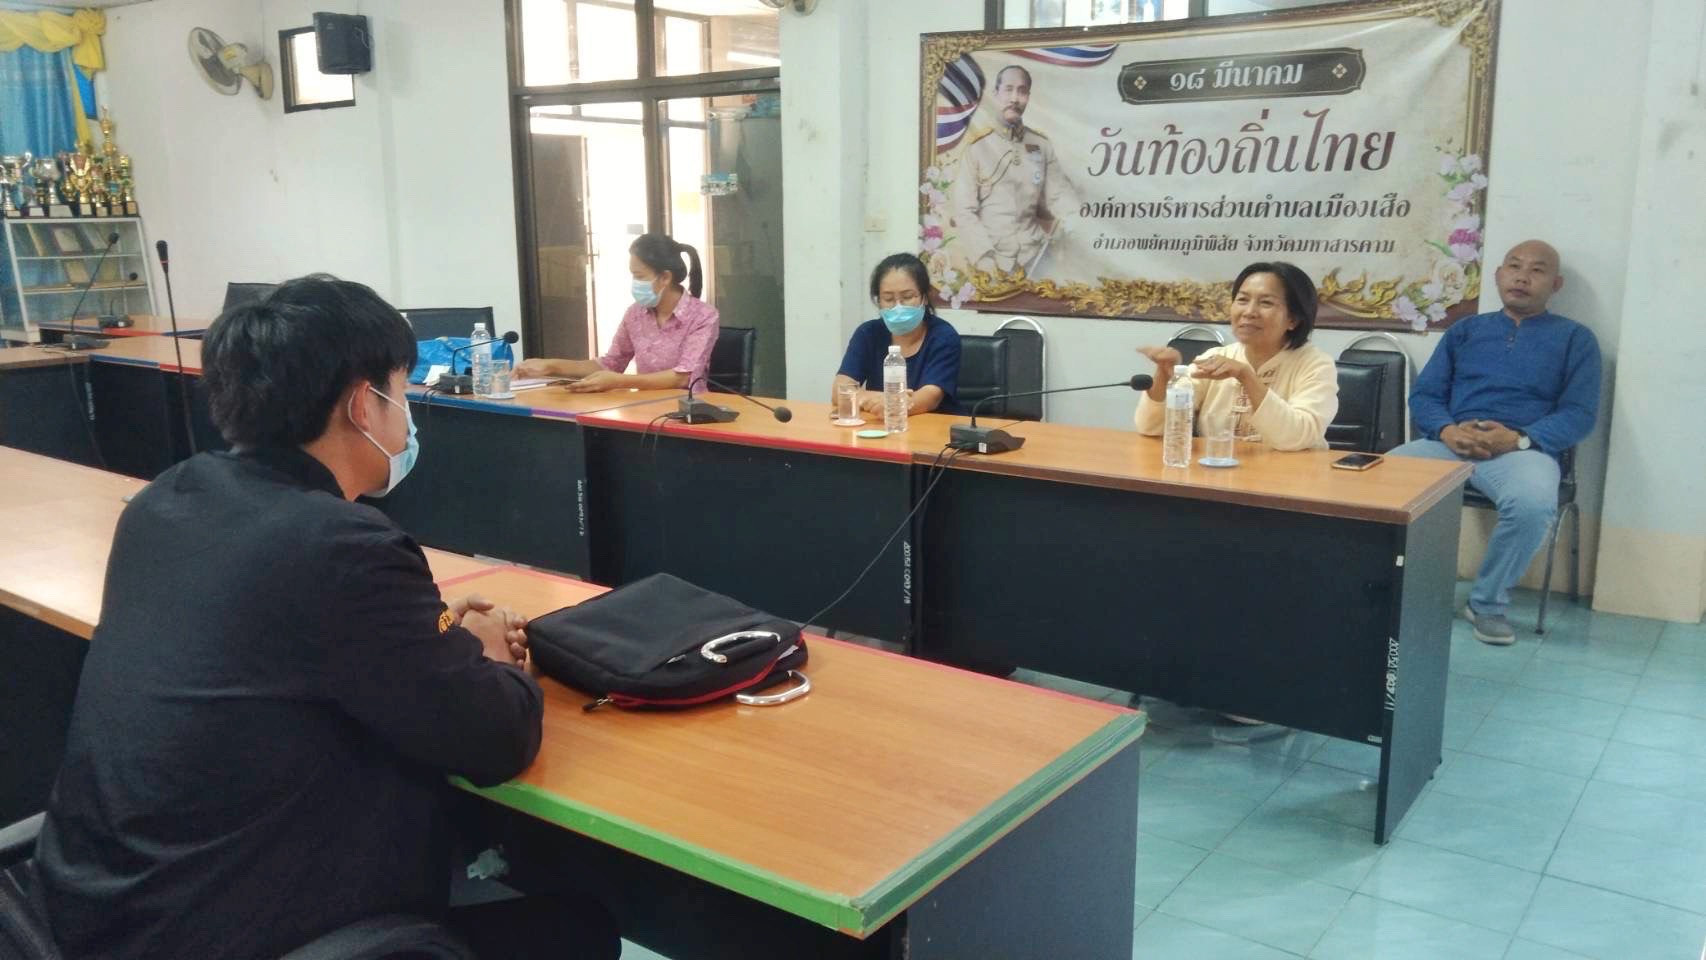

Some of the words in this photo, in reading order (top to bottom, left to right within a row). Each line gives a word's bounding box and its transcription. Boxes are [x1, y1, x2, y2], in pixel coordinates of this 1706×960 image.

[1168, 68, 1207, 92] ๑๘
[1212, 60, 1304, 89] มีนาคม
[1087, 108, 1396, 177] วันท้องถิ่นไทย
[1079, 193, 1412, 219] องค์การบริหารส่วนตำบลเมืองเสือ
[1243, 234, 1396, 254] จังหวัดมหาสารคาม
